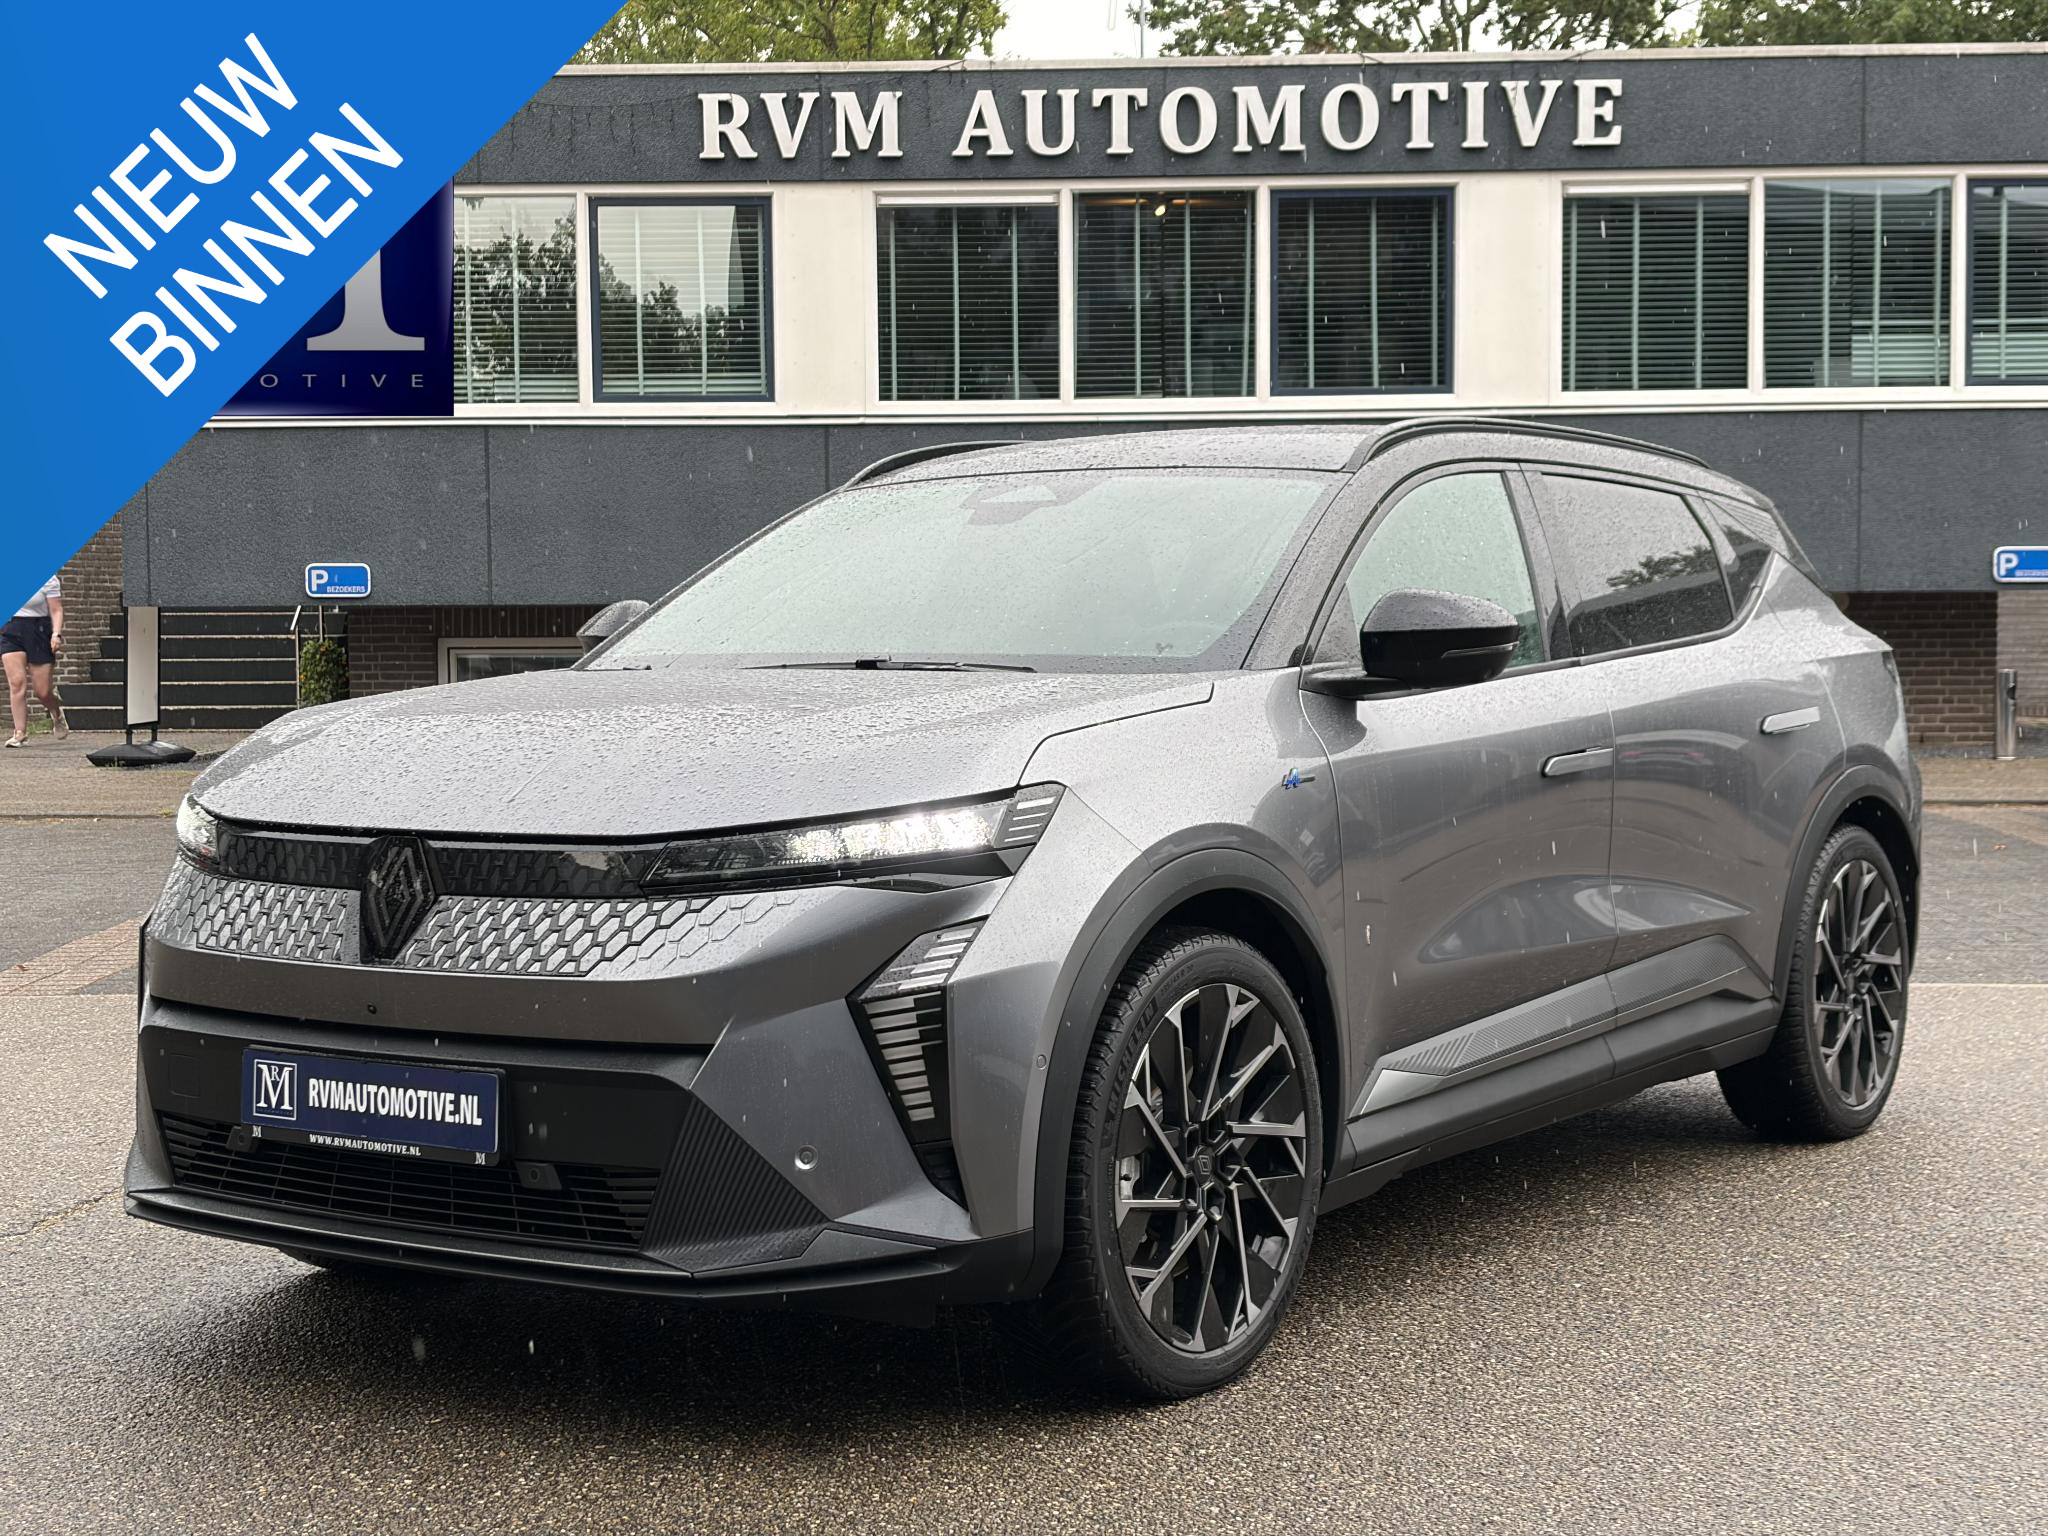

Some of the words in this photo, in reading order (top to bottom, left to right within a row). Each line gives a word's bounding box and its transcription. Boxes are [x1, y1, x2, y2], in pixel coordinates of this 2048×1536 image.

[699, 91, 904, 159] RVM
[952, 79, 1623, 157] AUTOMOTIVE
[2000, 553, 2018, 576] P
[311, 569, 328, 591] P
[308, 1078, 483, 1126] RVMAUTOMOTIVE.NL
[309, 1134, 422, 1156] WWW.RVMAUTOMOTIVE.NL
